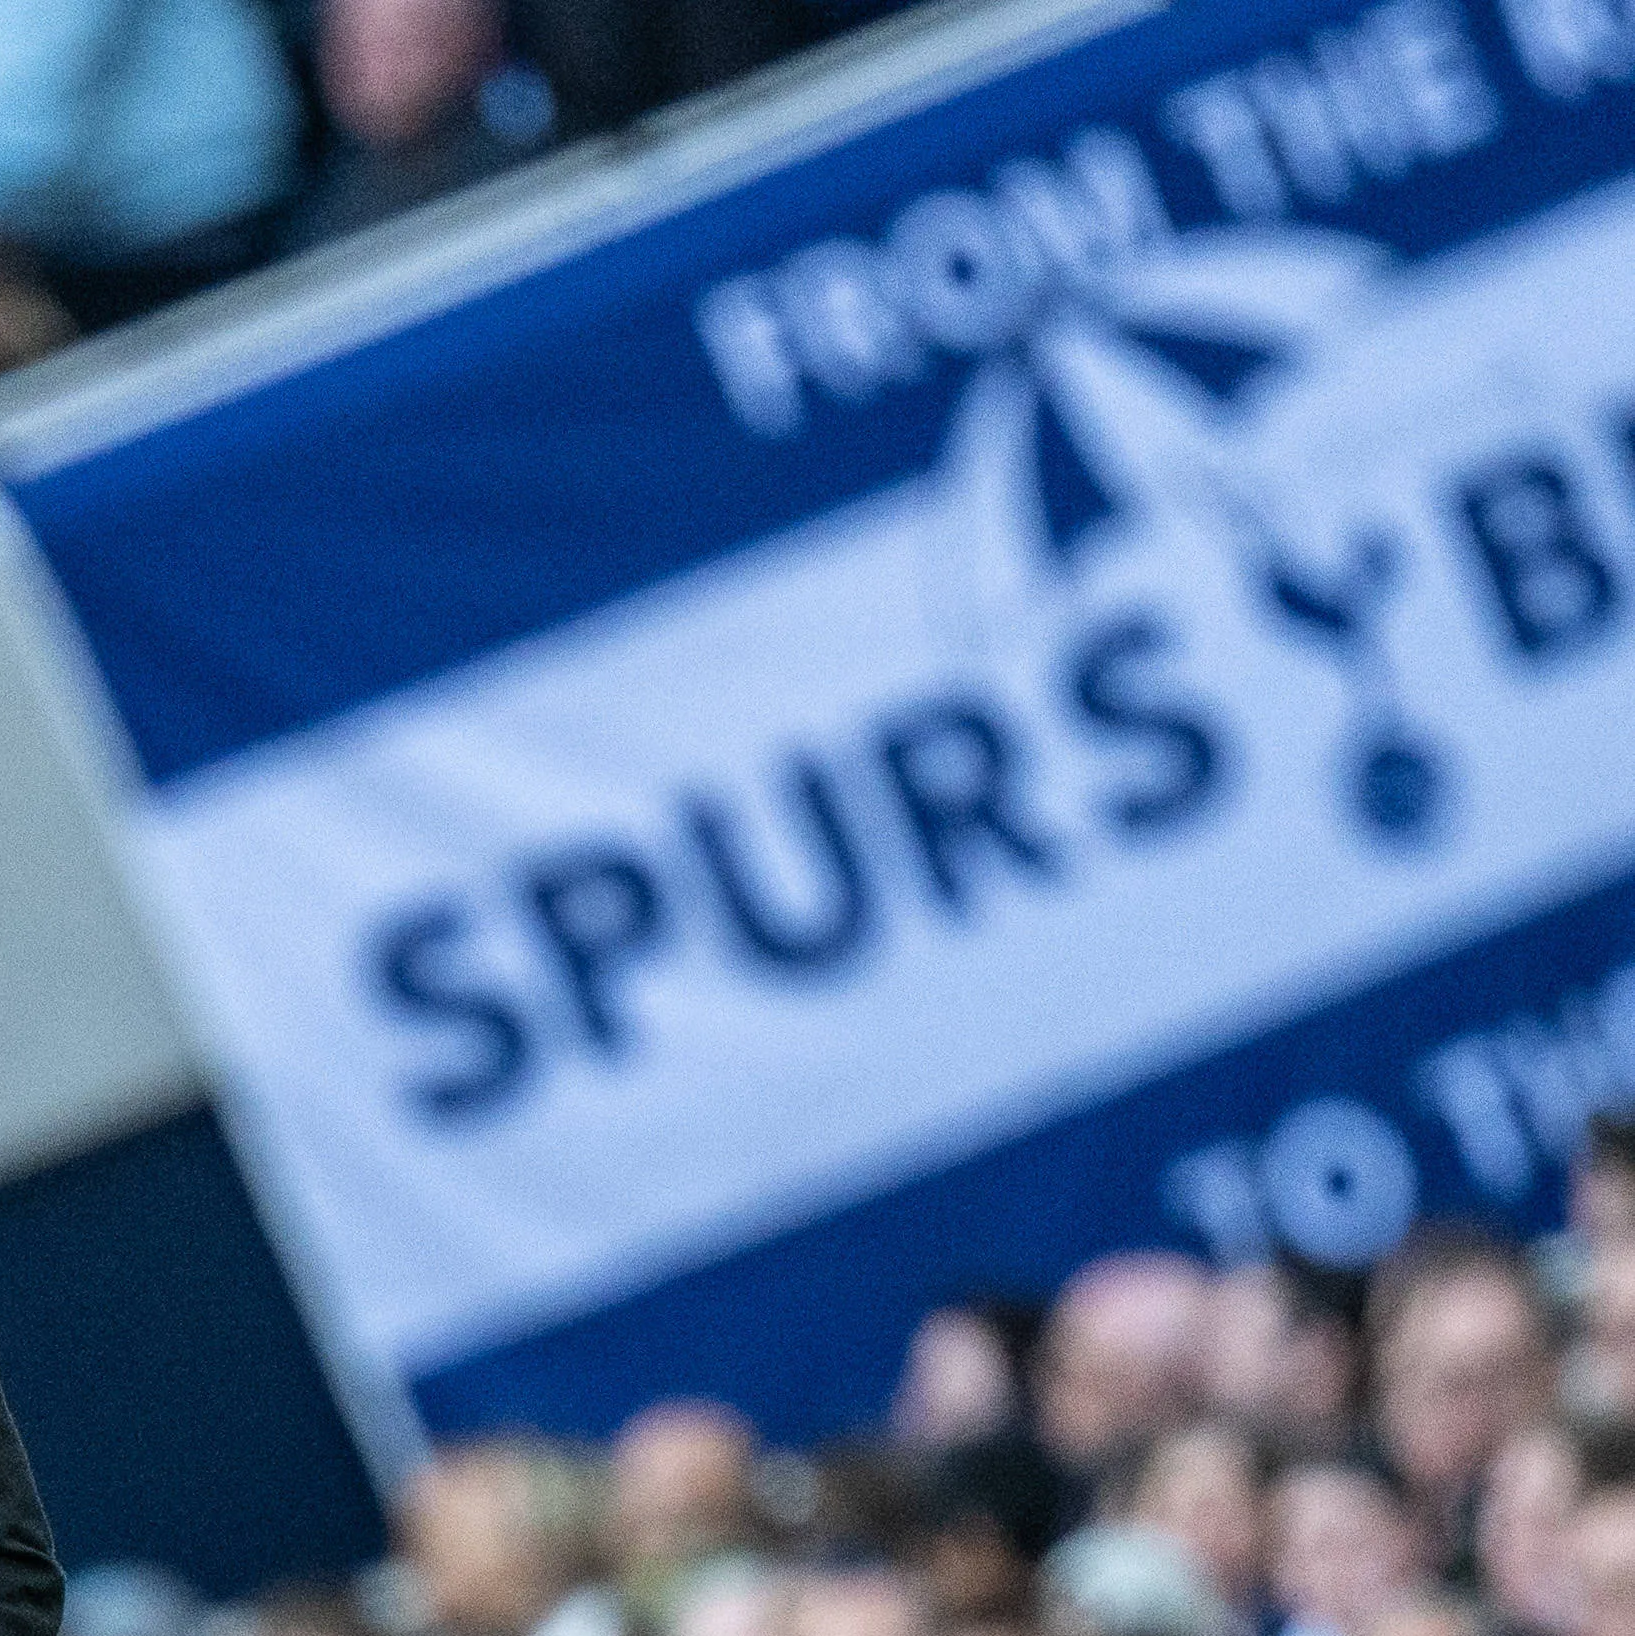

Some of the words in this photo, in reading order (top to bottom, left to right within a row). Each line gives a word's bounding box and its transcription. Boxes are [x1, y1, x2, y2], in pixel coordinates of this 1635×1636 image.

[692, 124, 1174, 438] FROM
[1161, 0, 1503, 218] THE
[359, 612, 1241, 1134] SPURS
[1162, 1095, 1419, 1268] TO
